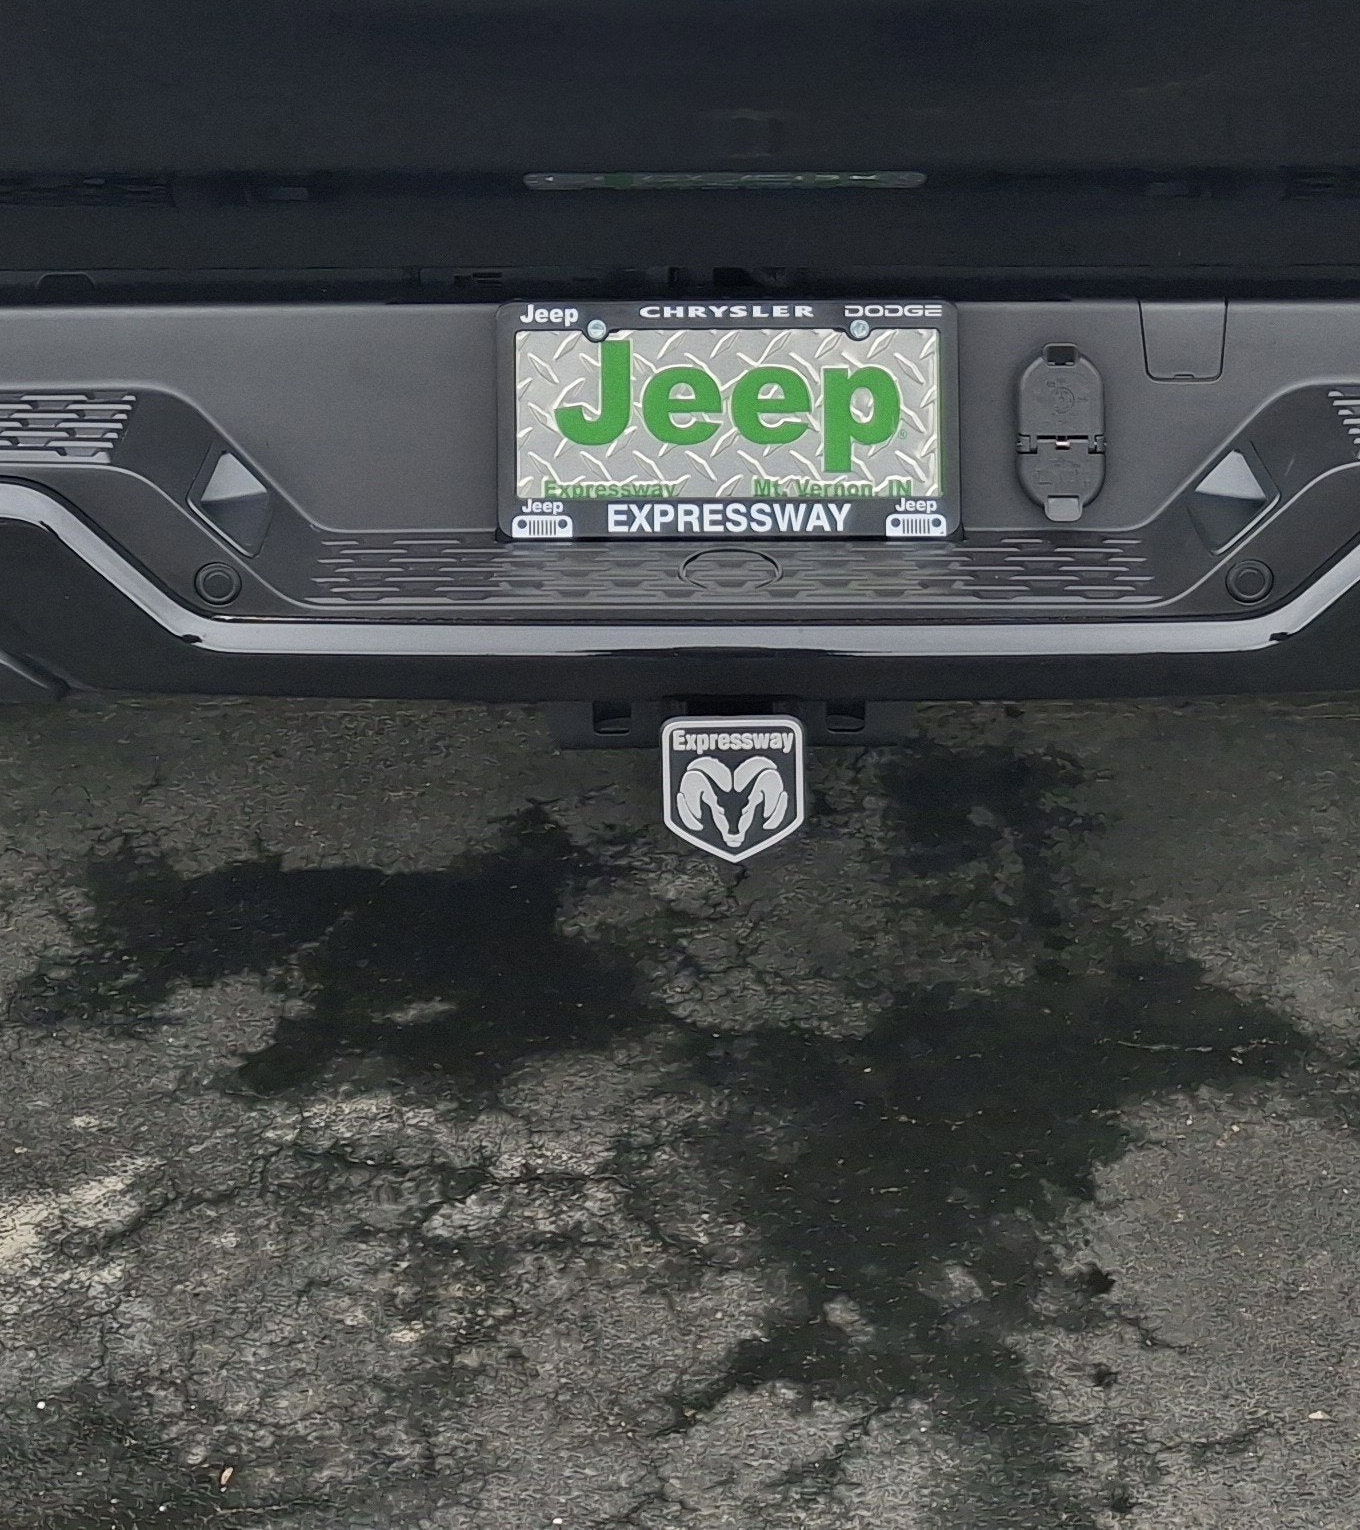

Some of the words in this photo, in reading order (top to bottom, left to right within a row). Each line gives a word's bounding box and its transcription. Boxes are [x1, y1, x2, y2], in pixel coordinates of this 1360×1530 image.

[520, 304, 578, 326] Jeep
[640, 305, 814, 318] CHRYSLER
[844, 305, 942, 317] DODGE
[554, 340, 901, 473] Jeep
[544, 480, 676, 497] Expressway
[754, 479, 788, 497] Mt.
[888, 479, 912, 497] IN
[522, 499, 564, 514] Jeep
[895, 498, 937, 513] Jeep
[608, 503, 851, 533] EXPRESSWAY
[672, 729, 793, 754] Expressway
